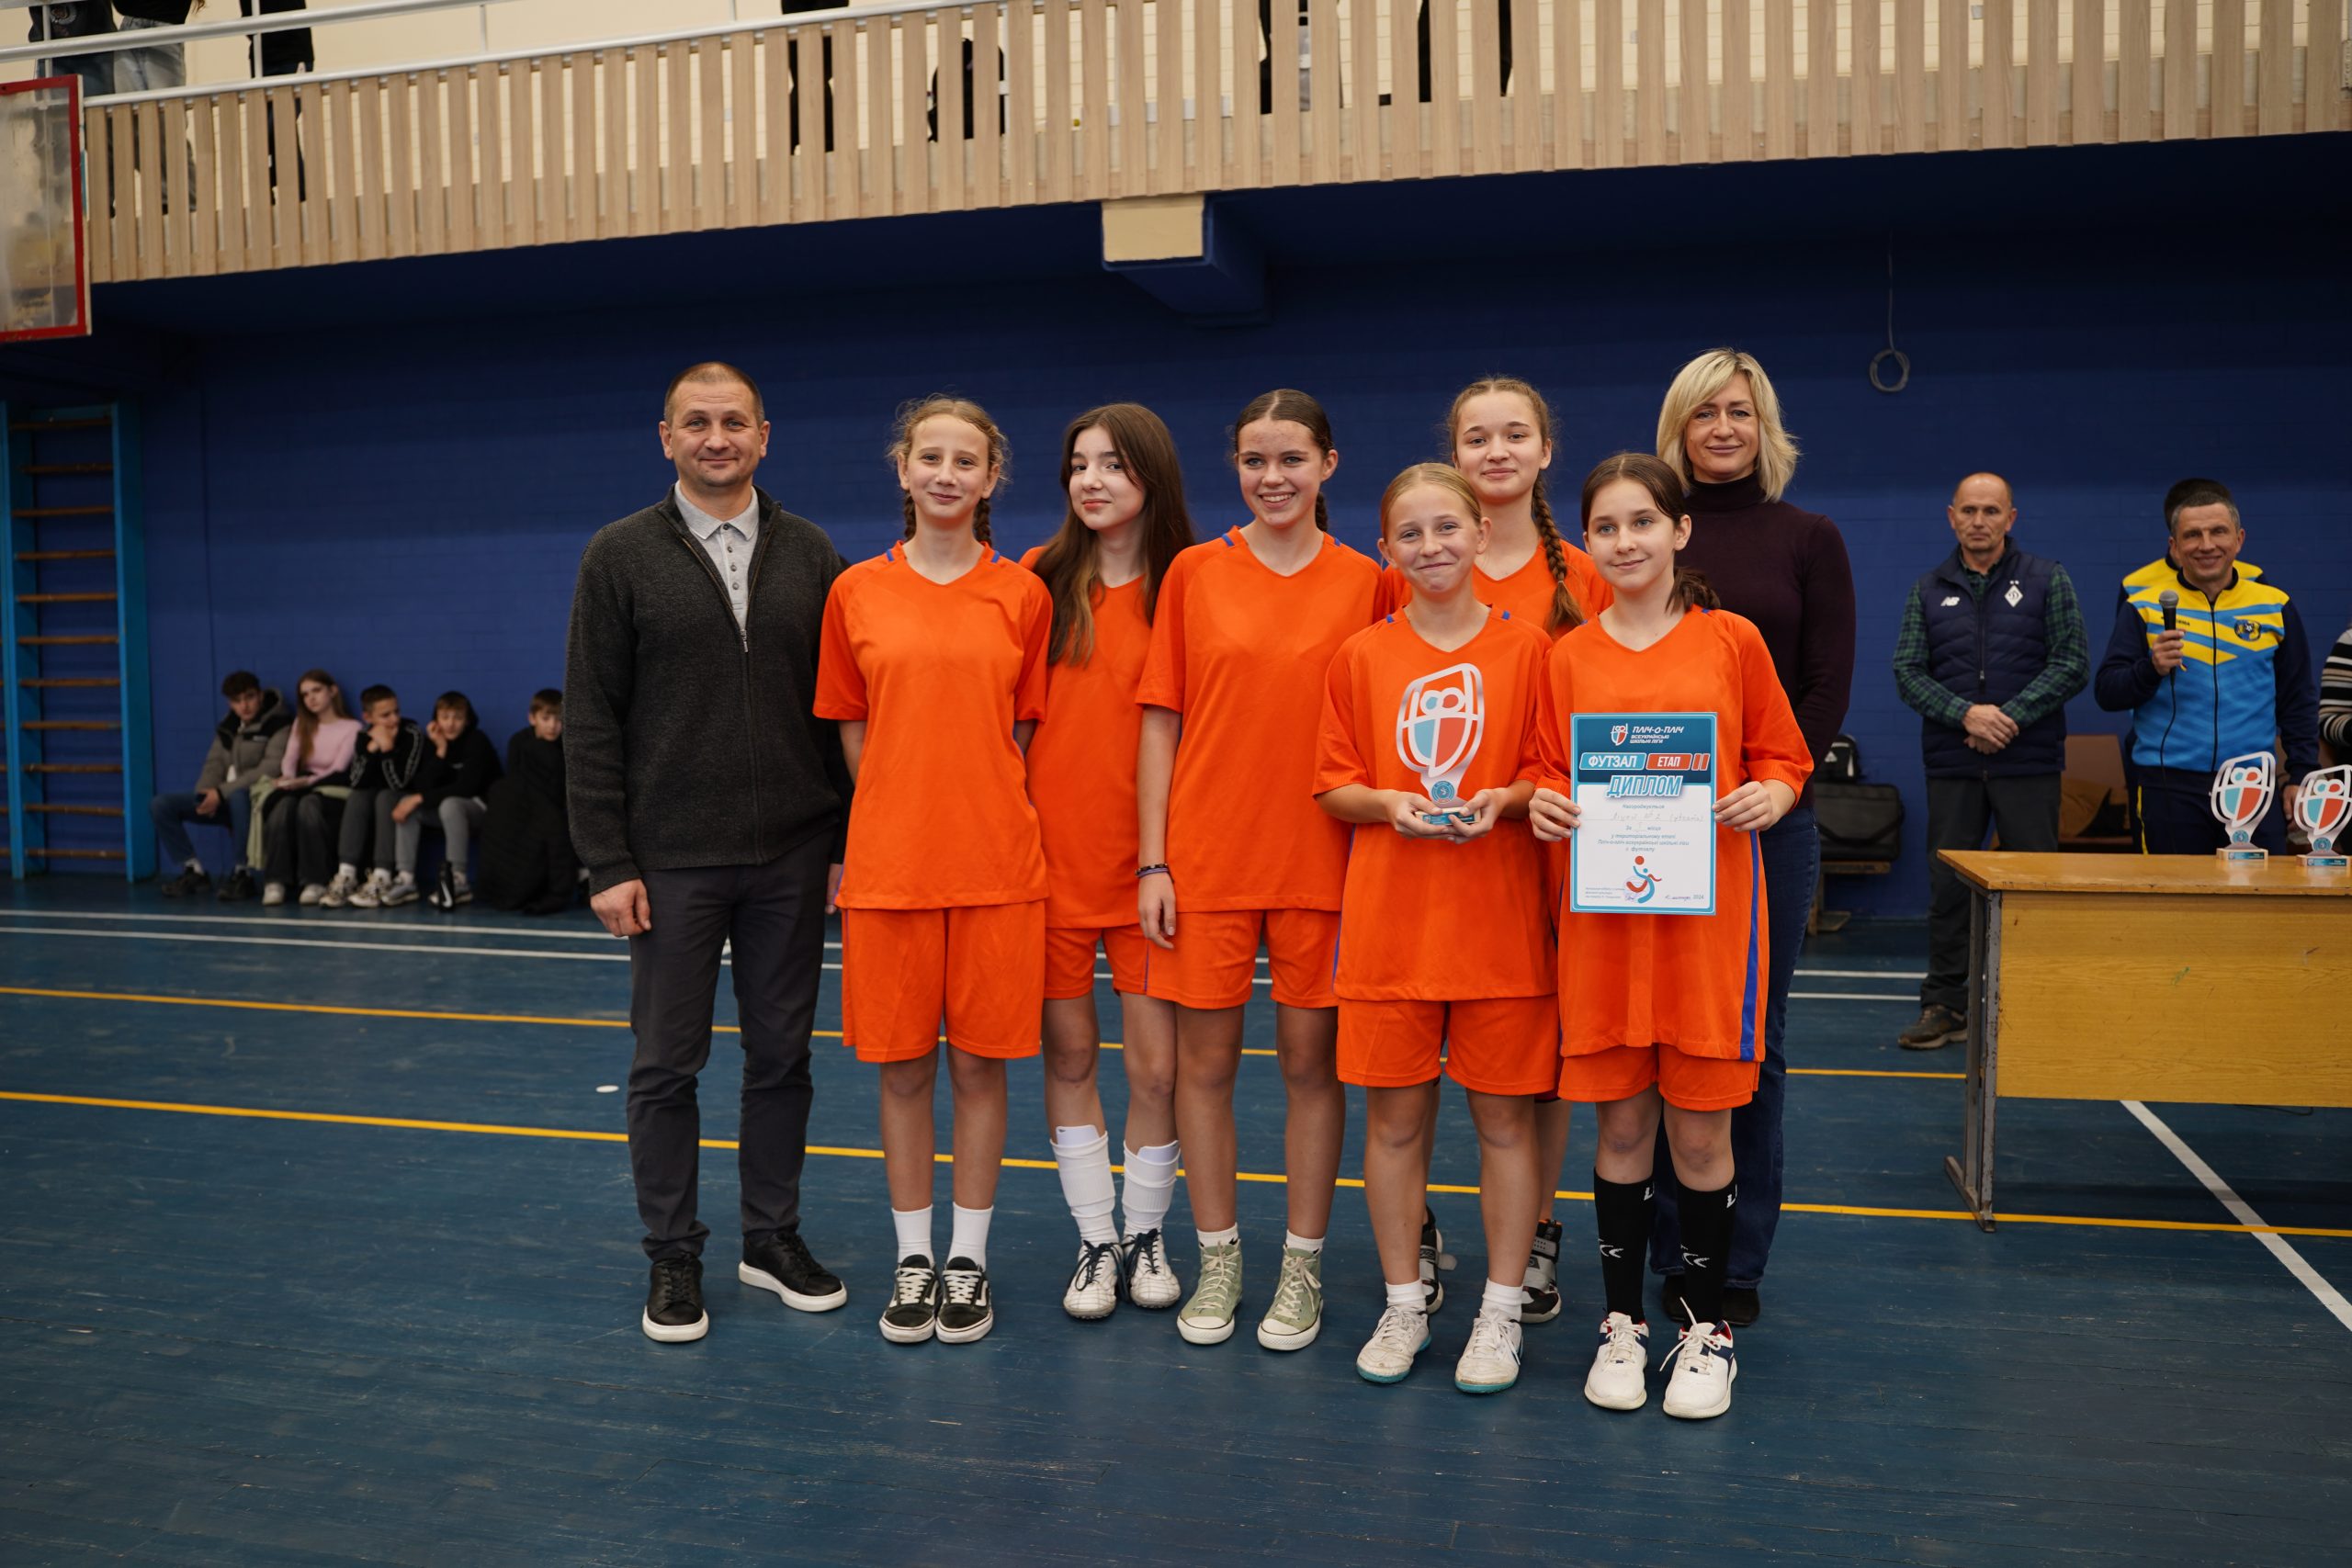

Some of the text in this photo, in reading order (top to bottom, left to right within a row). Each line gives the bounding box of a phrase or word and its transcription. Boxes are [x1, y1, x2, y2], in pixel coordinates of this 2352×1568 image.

[1589, 755, 1637, 768] ФУТЗАЛ
[1657, 756, 1680, 767] ЕТАП
[1608, 775, 1683, 797] ДИПЛОМ
